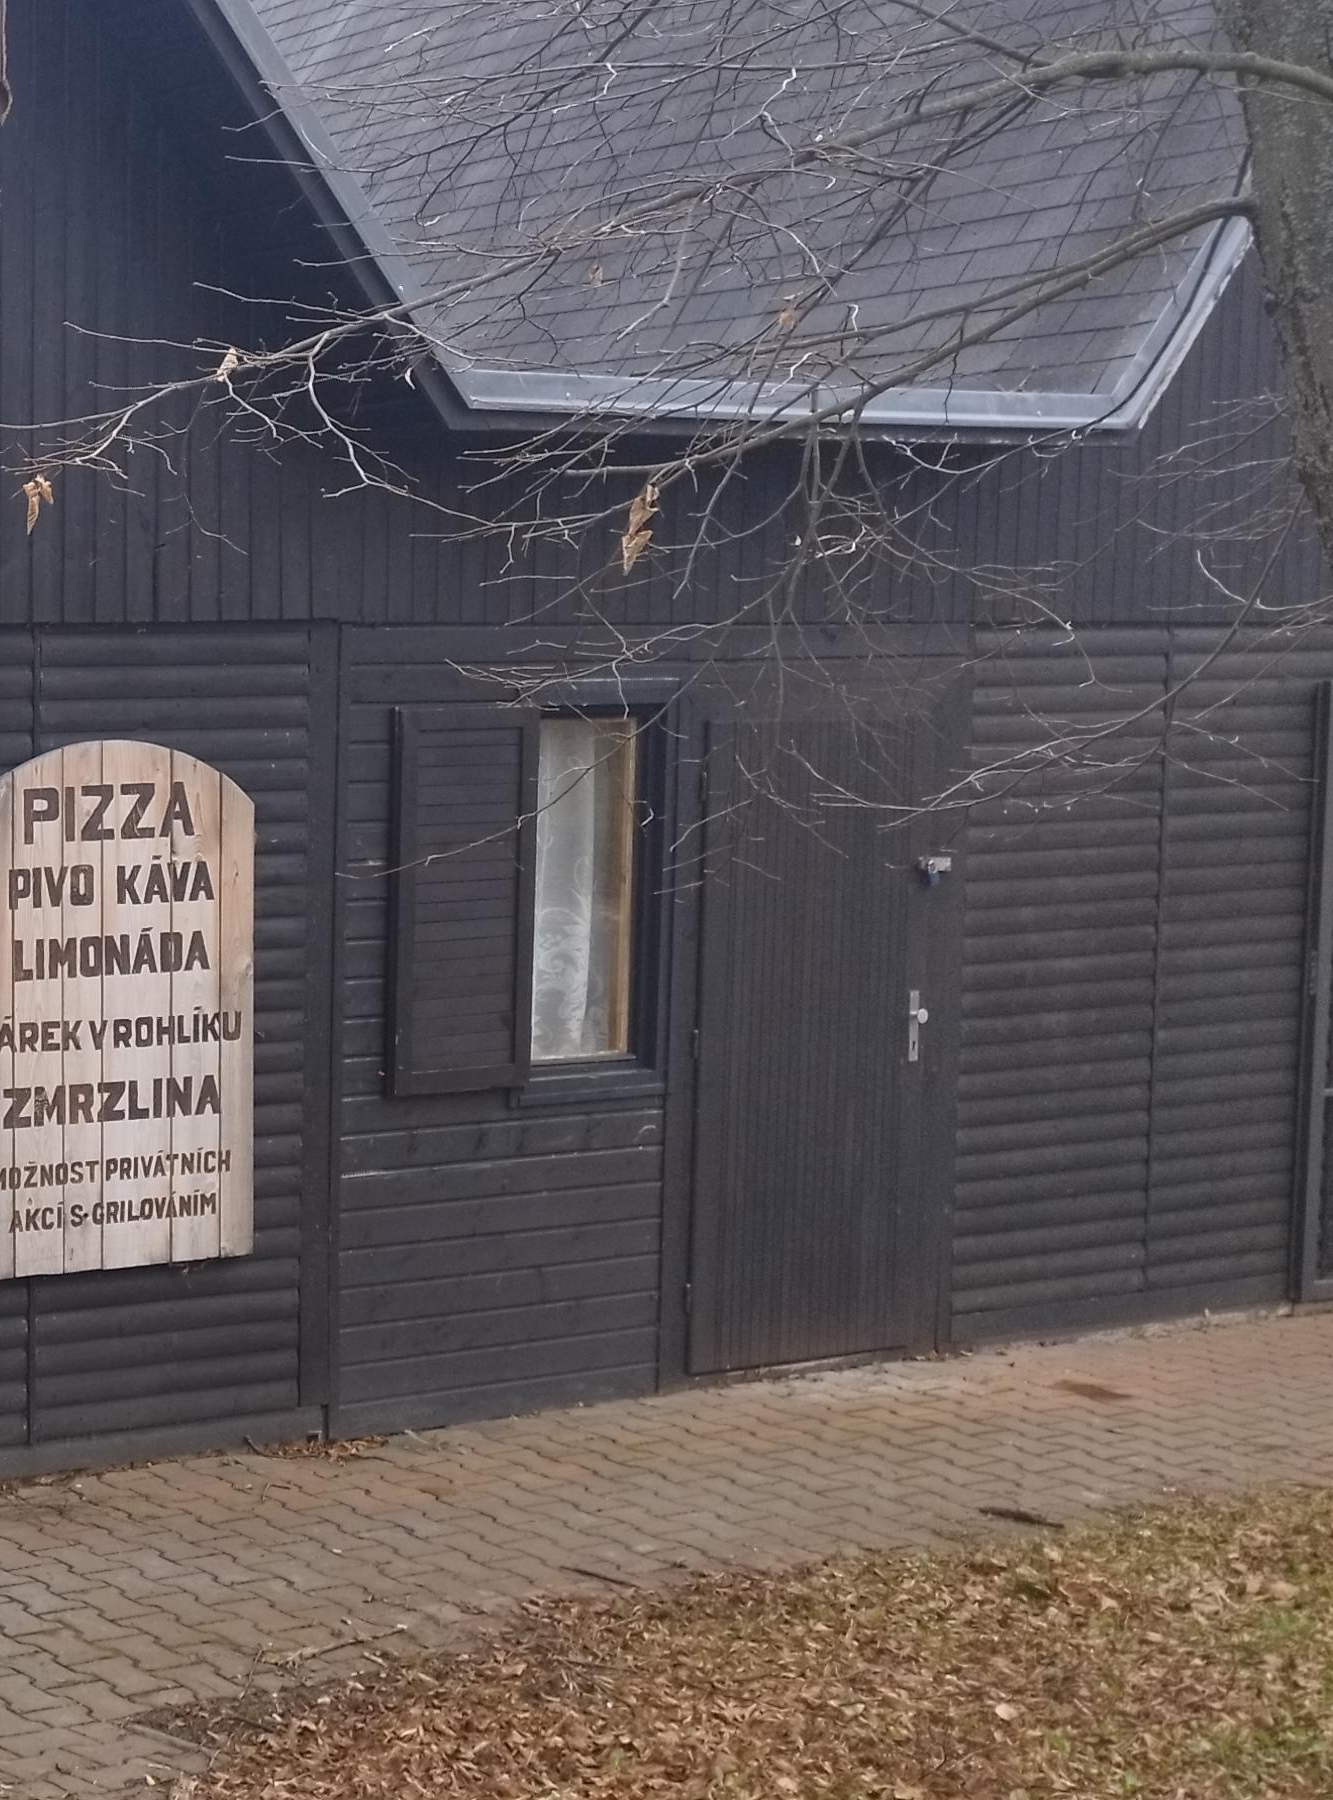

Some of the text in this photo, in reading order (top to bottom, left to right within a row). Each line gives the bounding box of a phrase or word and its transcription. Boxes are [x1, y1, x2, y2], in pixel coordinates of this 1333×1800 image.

[23, 781, 195, 845] PIZZA
[8, 855, 215, 910] PIVO KÁVA
[14, 927, 210, 982] LIMONÁDA
[89, 1019, 109, 1051] V
[113, 1006, 242, 1049] ROHLÍKU
[2, 1074, 222, 1130] ZMRZLINA
[105, 1147, 231, 1182] PRIVÁTNÍCH
[8, 1189, 217, 1233] AKCÍ S GRILOVÁNÍM
